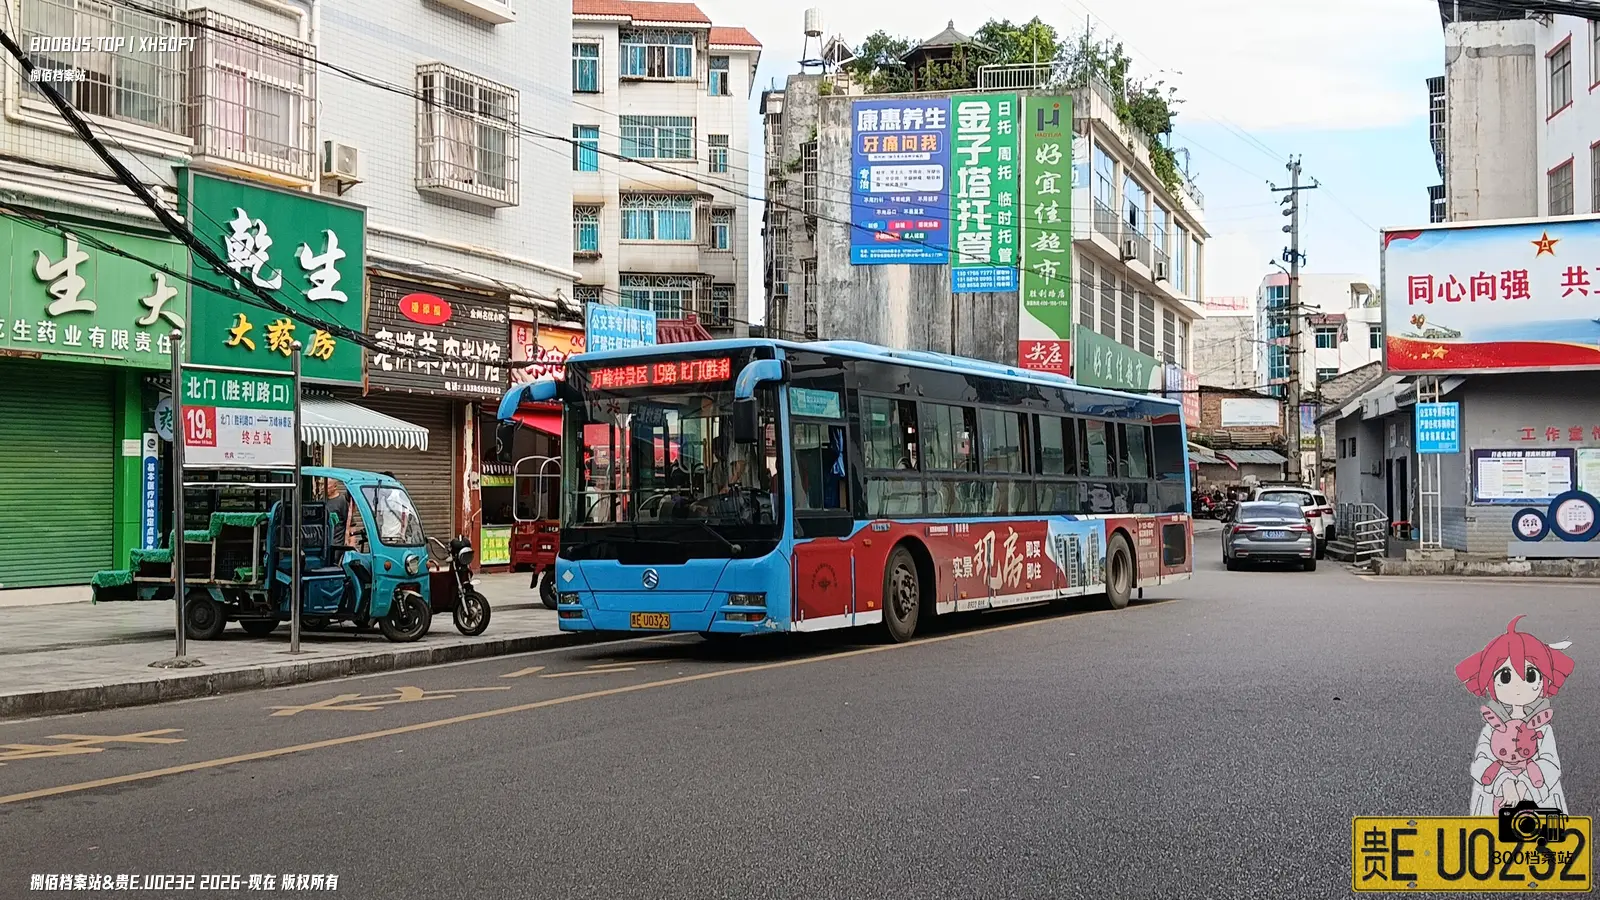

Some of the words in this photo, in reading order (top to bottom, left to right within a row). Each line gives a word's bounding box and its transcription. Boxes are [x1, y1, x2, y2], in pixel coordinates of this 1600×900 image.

[857, 107, 946, 131] 康惠养生
[997, 101, 1012, 135] 日托
[863, 134, 937, 152] 牙痛问我
[997, 146, 1012, 180] 周托
[957, 101, 992, 264] 金子塔托管
[997, 191, 1012, 263] 临时托管
[1030, 143, 1065, 285] 好宜佳超市
[1408, 268, 1531, 305] 同心向强
[1560, 265, 1600, 299] 共
[0, 319, 186, 354] 生药业有限责任
[223, 312, 337, 360] 大药房
[1024, 342, 1064, 365] 尖庄
[1093, 343, 1143, 389] 好宜佳超市
[590, 365, 648, 388] 万峰林景区
[241, 430, 272, 445] 终点站
[952, 556, 973, 578] 实景
